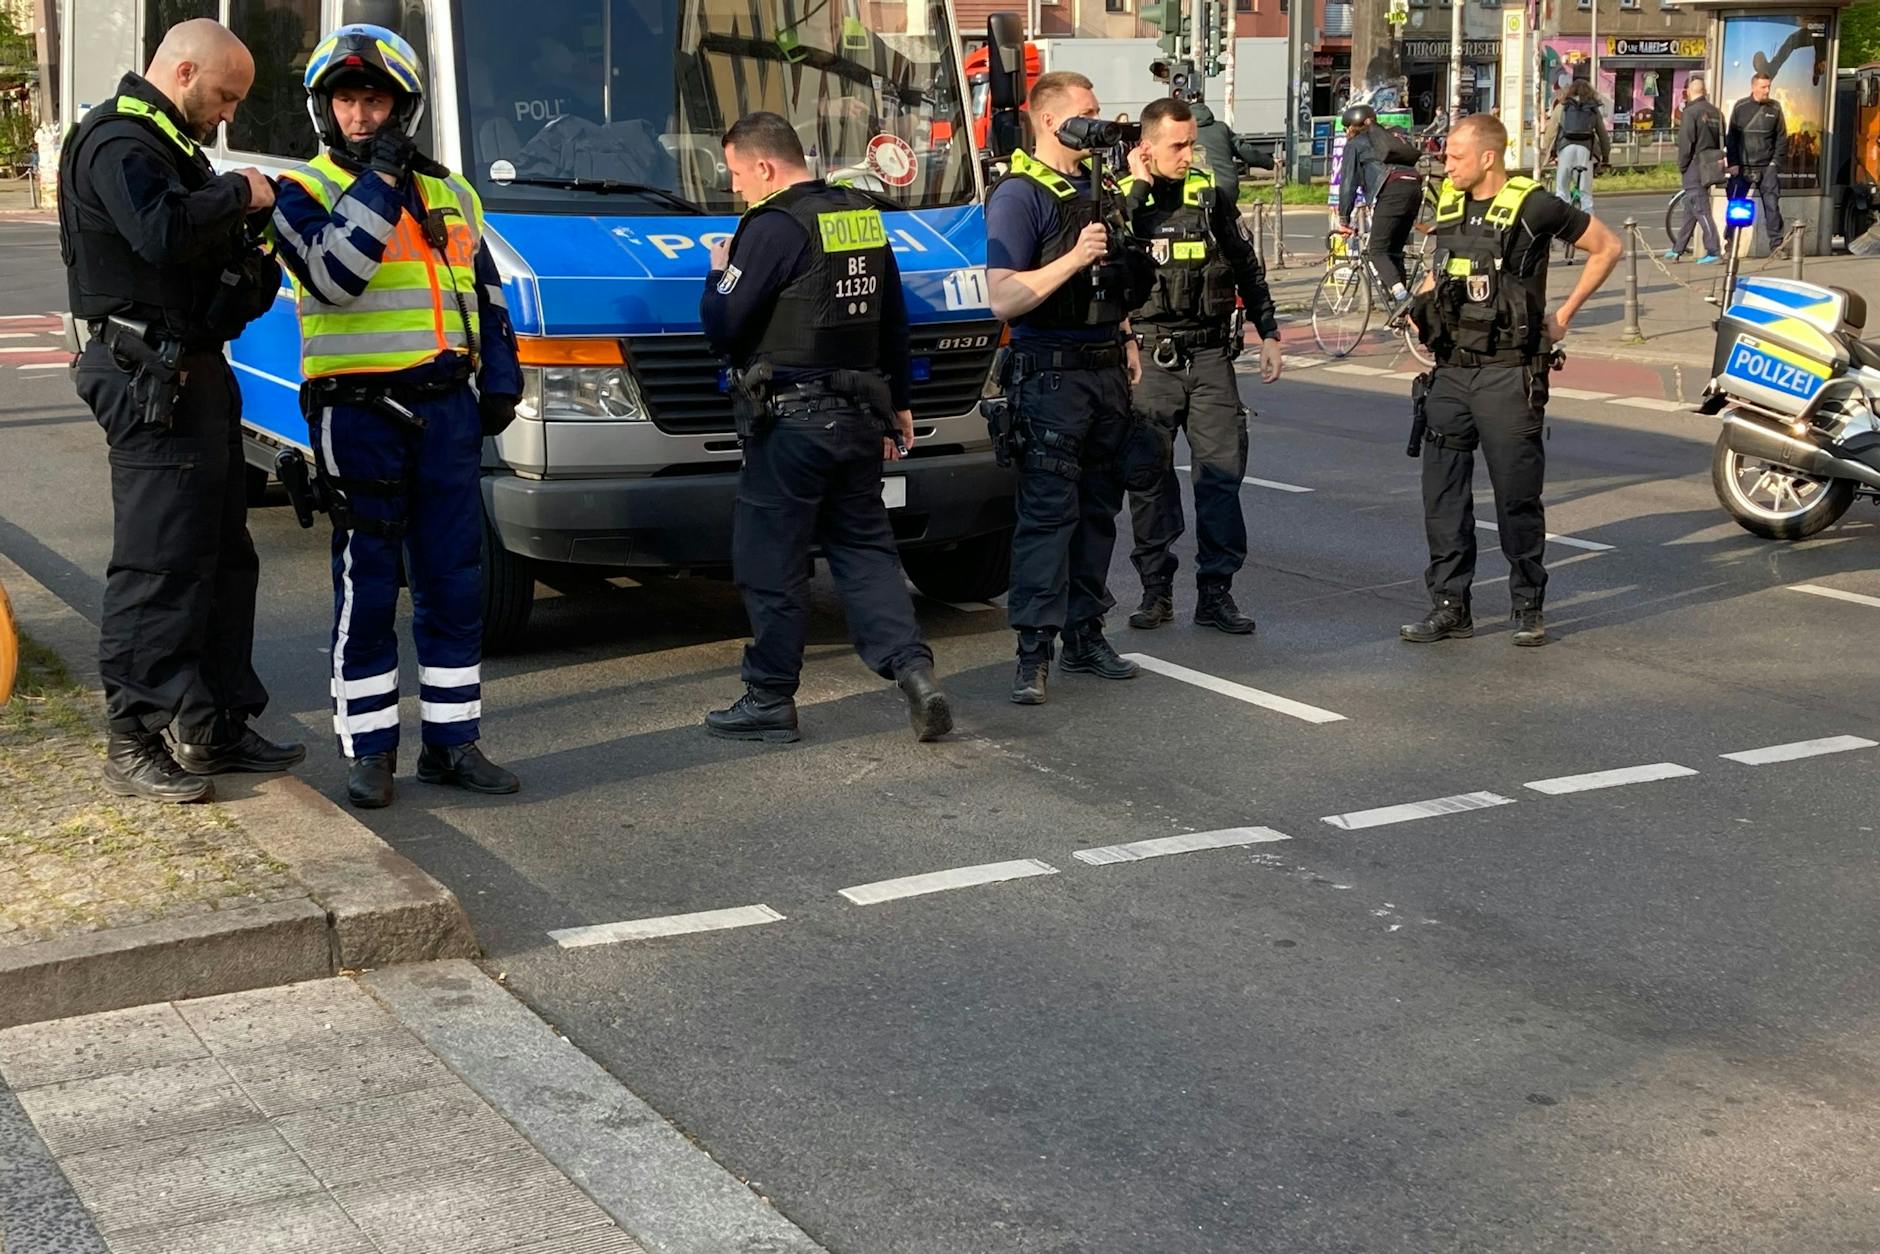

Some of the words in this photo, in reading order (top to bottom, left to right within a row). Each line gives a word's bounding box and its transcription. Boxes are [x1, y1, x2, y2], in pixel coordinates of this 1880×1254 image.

[514, 99, 565, 121] POLI
[823, 215, 883, 246] POLIZEI
[848, 256, 866, 275] BE
[835, 276, 877, 298] 11320
[950, 273, 982, 305] 11
[938, 336, 972, 349] 813
[975, 335, 989, 347] D
[1734, 349, 1815, 395] POLIZEI
